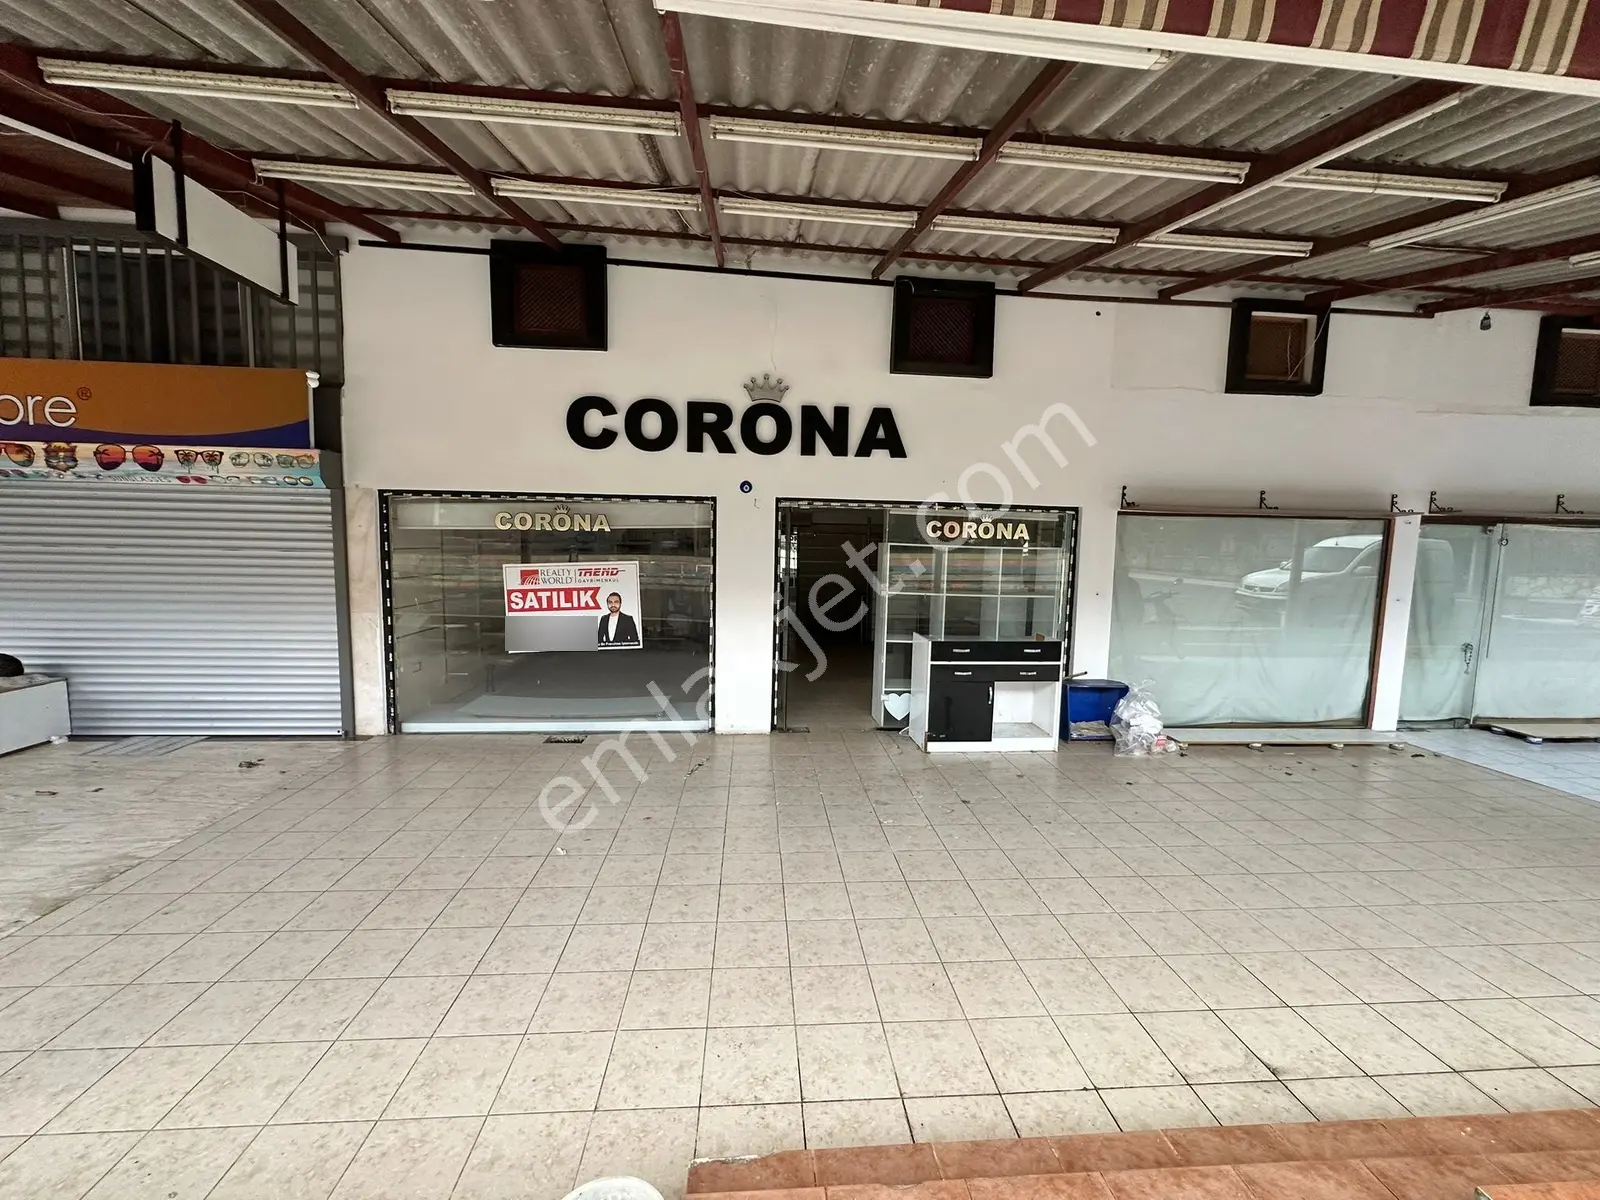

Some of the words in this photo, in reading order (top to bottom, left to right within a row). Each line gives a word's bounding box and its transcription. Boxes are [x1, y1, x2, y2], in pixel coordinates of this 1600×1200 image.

[566, 396, 907, 458] CORONA
[495, 512, 611, 533] CORONA
[926, 520, 1030, 540] CORONA
[540, 568, 572, 577] REALTY
[541, 577, 573, 585] WORLD
[577, 567, 621, 577] TREND
[510, 590, 596, 610] SATILIK
